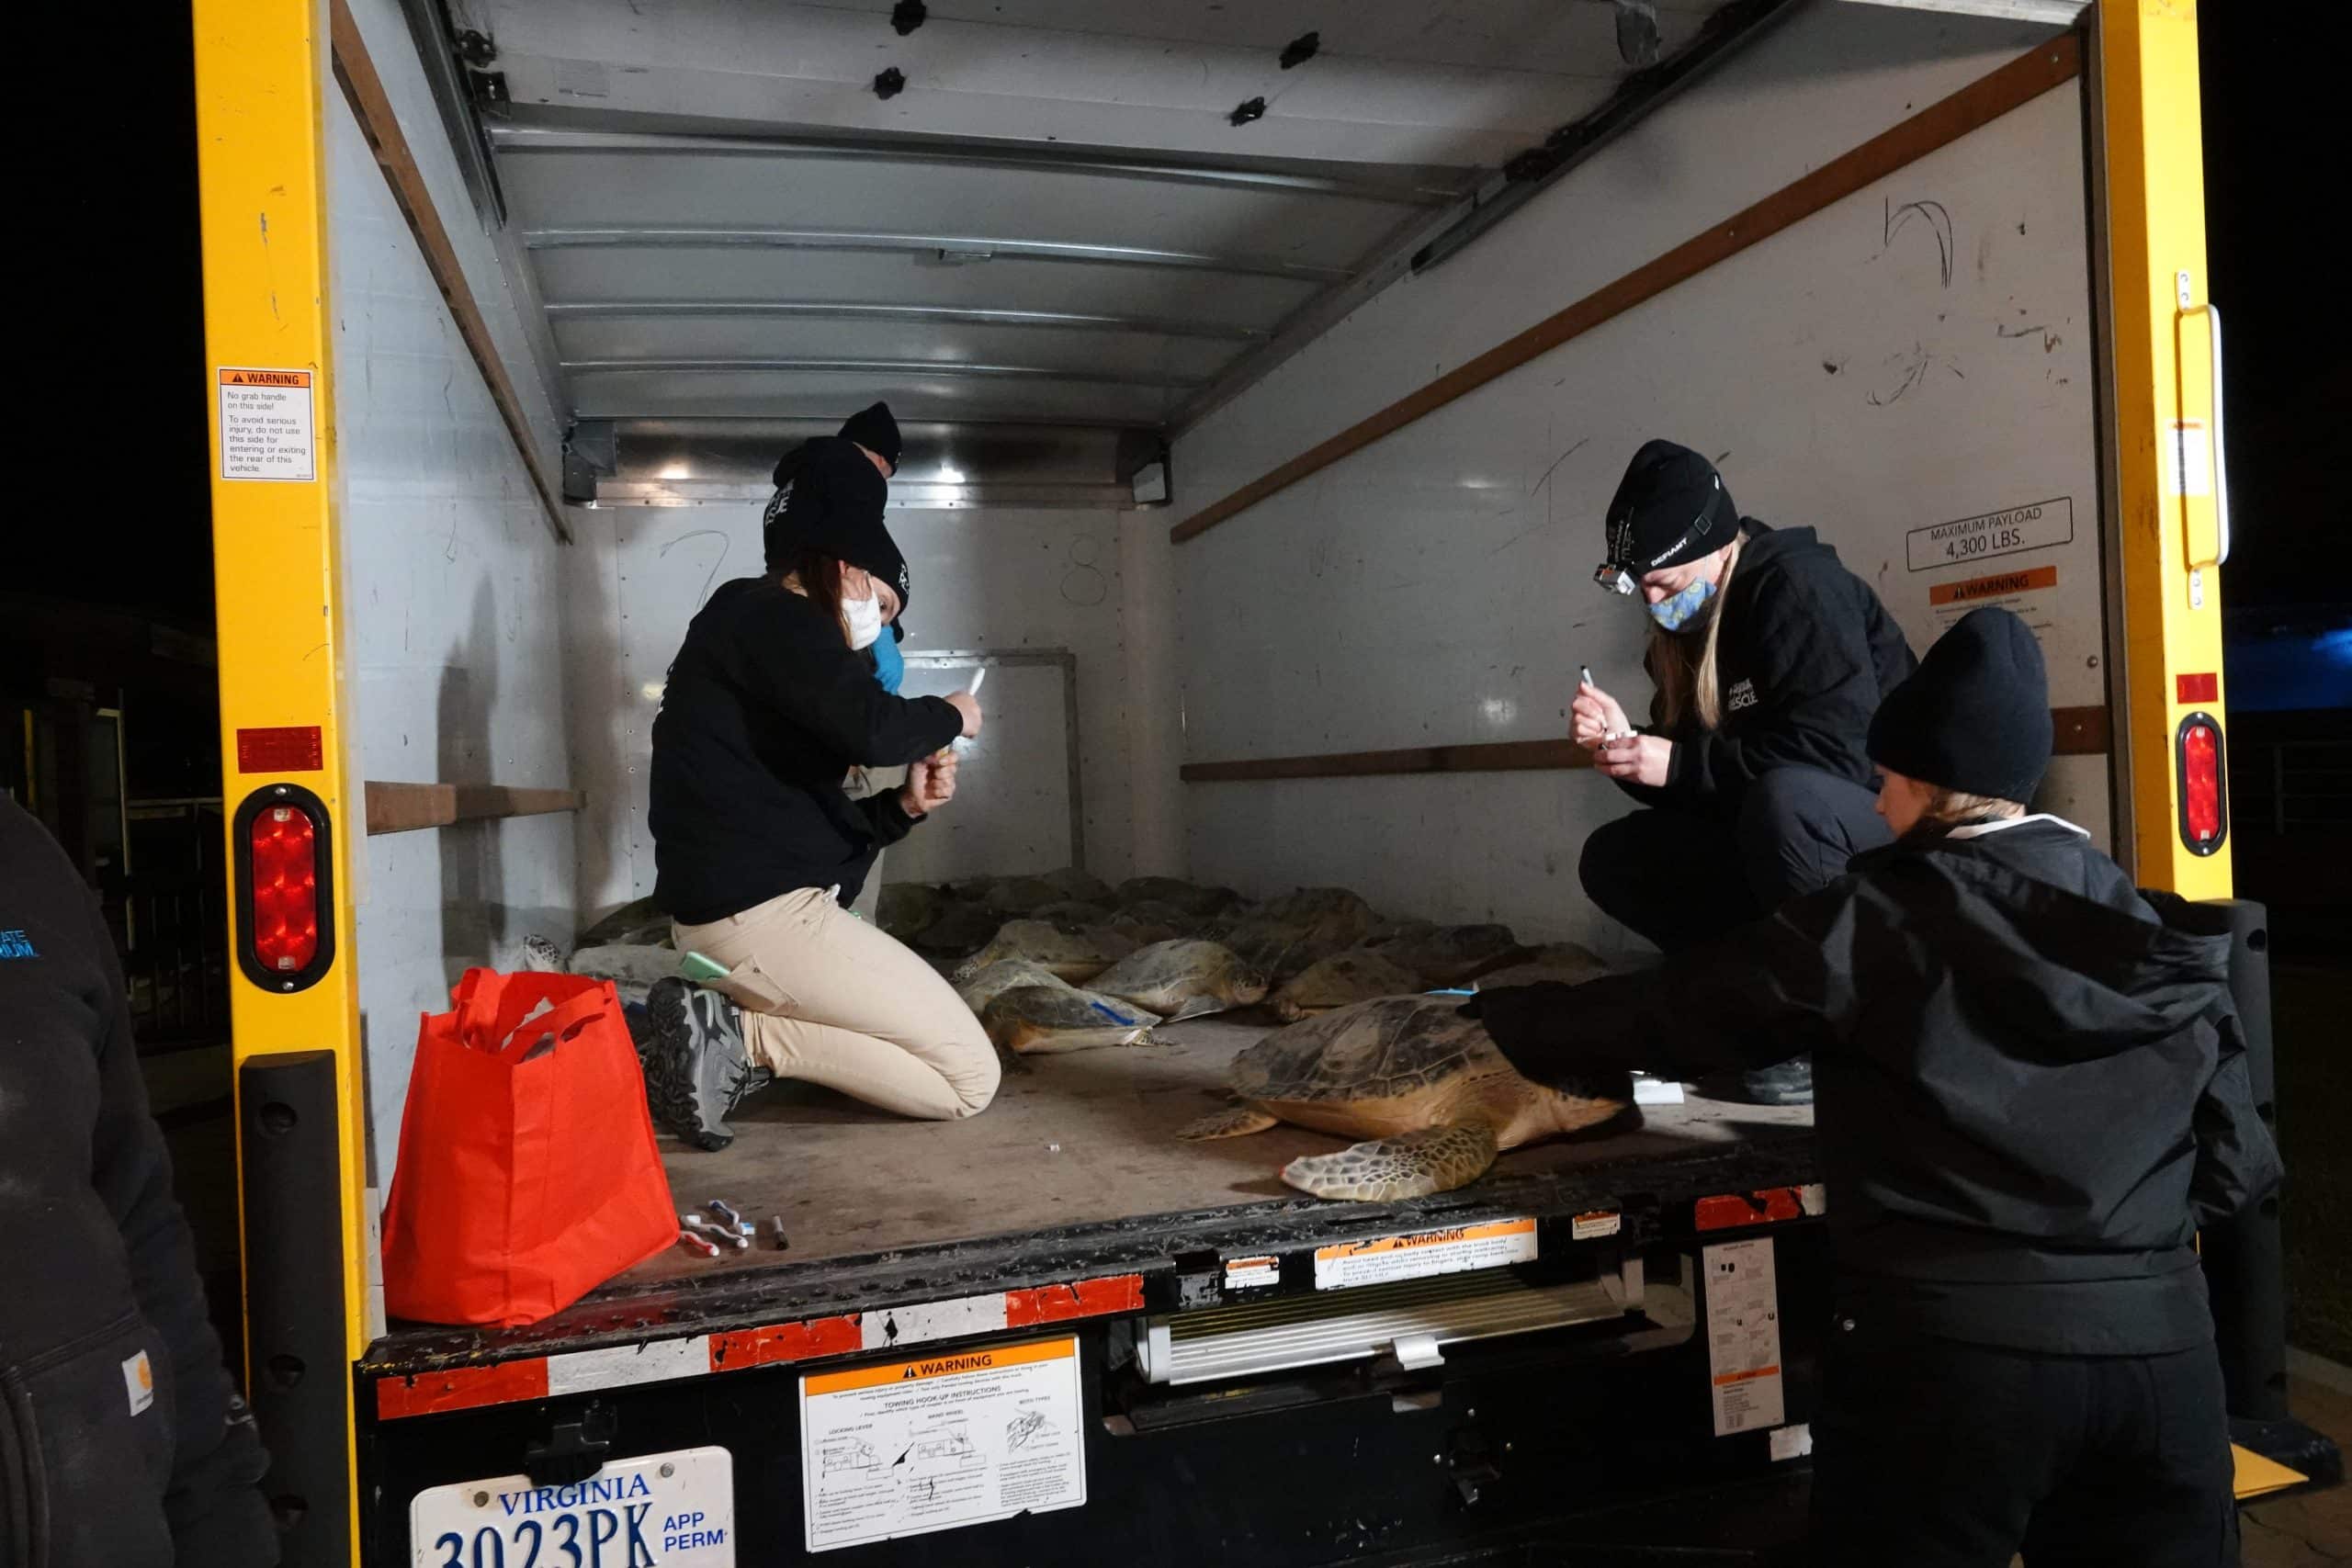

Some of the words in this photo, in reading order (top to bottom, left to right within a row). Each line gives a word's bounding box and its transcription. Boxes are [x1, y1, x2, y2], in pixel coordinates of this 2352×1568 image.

[247, 373, 300, 385] WARNING
[227, 391, 239, 400] No
[242, 392, 259, 400] grab
[228, 415, 239, 423] To
[229, 425, 253, 434] injury,
[230, 446, 265, 454] entering
[278, 447, 306, 456] exiting
[1930, 519, 1985, 541] MAXIMUM
[1987, 507, 2042, 530] PAYLOAD
[1650, 537, 1688, 567] DEFIANT
[1946, 535, 1987, 559] 4,300
[1991, 528, 2026, 550] LBS.
[1966, 574, 2030, 594] WARNING
[1407, 1230, 1464, 1247] WARNING
[921, 1354, 992, 1375] WARNING
[884, 1398, 914, 1409] TOWING
[950, 1384, 1001, 1398] INSTRUCTIONS
[498, 1472, 652, 1517] VIRGINIA
[662, 1511, 705, 1532] APP
[435, 1501, 661, 1568] 3023PK
[664, 1529, 725, 1552] PERM
